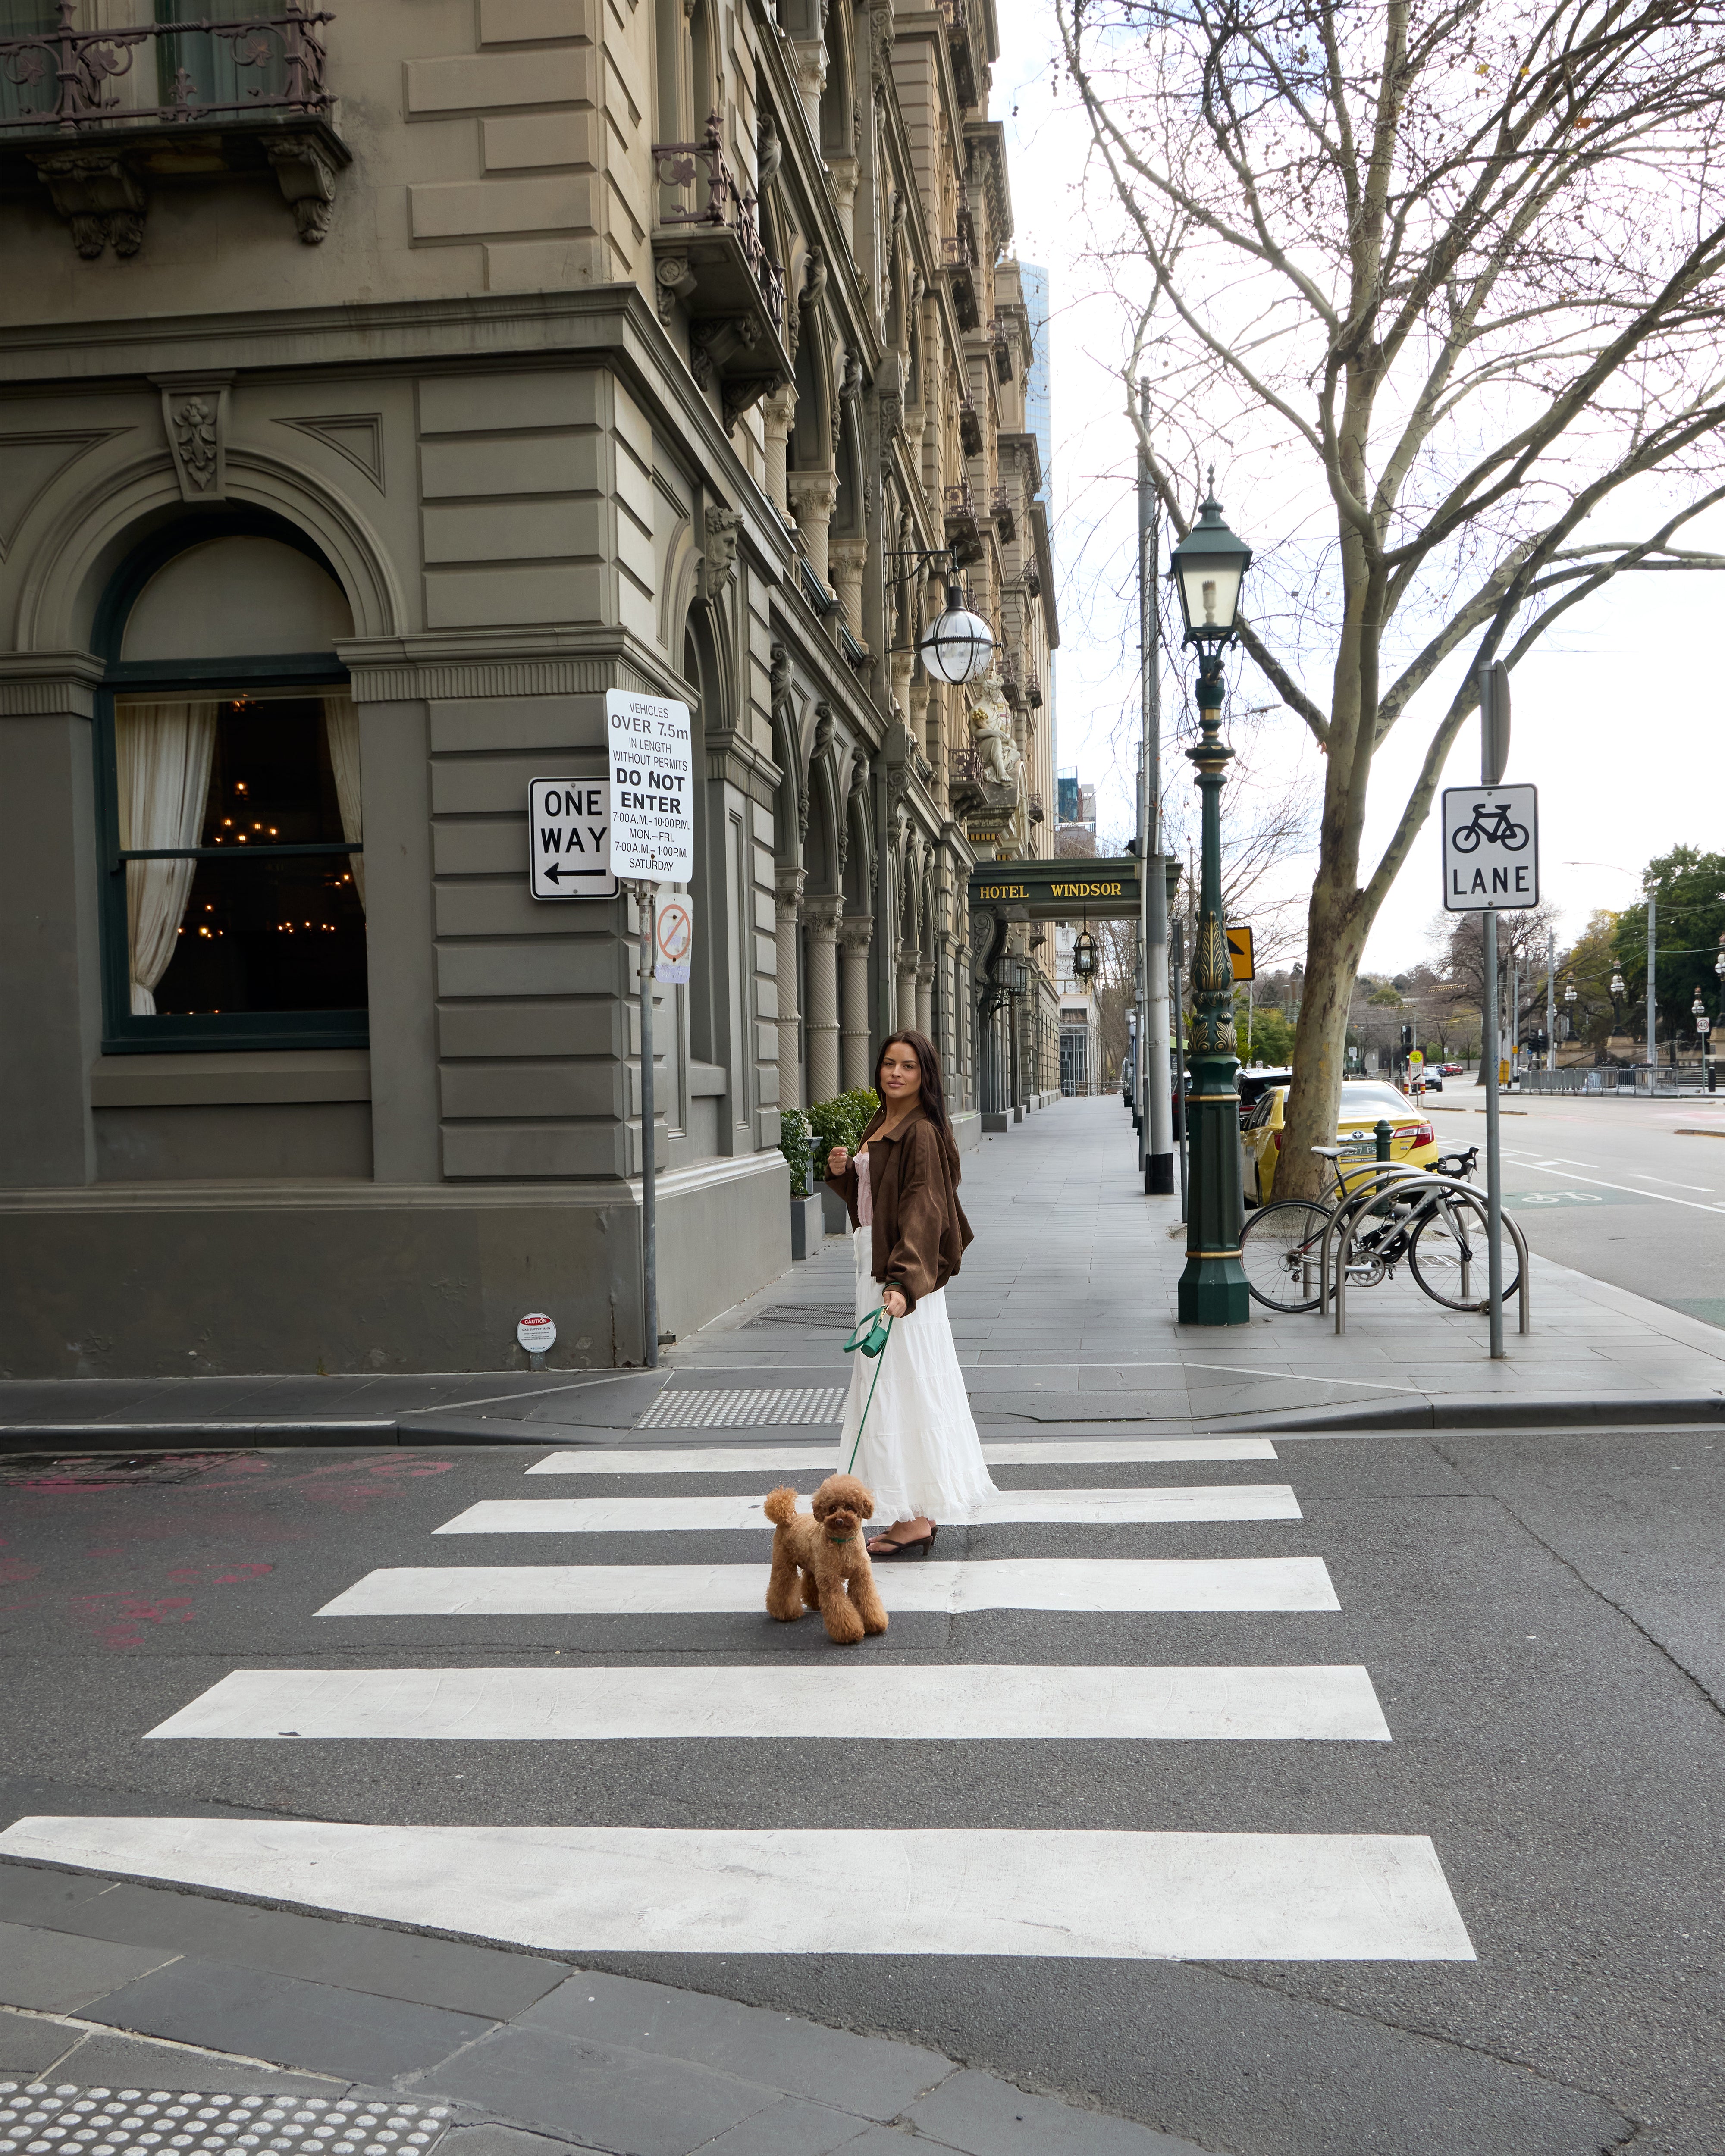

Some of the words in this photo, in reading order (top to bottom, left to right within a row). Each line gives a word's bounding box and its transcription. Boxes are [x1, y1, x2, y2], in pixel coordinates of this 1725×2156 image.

[629, 702, 668, 718] VEHICLES
[611, 714, 652, 734] OVER
[658, 722, 688, 740] 7.5m
[629, 737, 637, 748] IN
[640, 739, 671, 754] LENGTH
[613, 750, 650, 765] WITHOUT
[654, 757, 687, 771] PERMITS
[616, 768, 641, 786] DO
[649, 772, 685, 792] NOT
[545, 790, 602, 817] ONE
[621, 791, 681, 814] ENTER
[541, 827, 607, 853] WAY
[629, 858, 674, 871] SATURDAY
[980, 885, 1029, 899] HOTEL
[1051, 883, 1121, 897] WINDSOR
[1453, 866, 1529, 895] LANE
